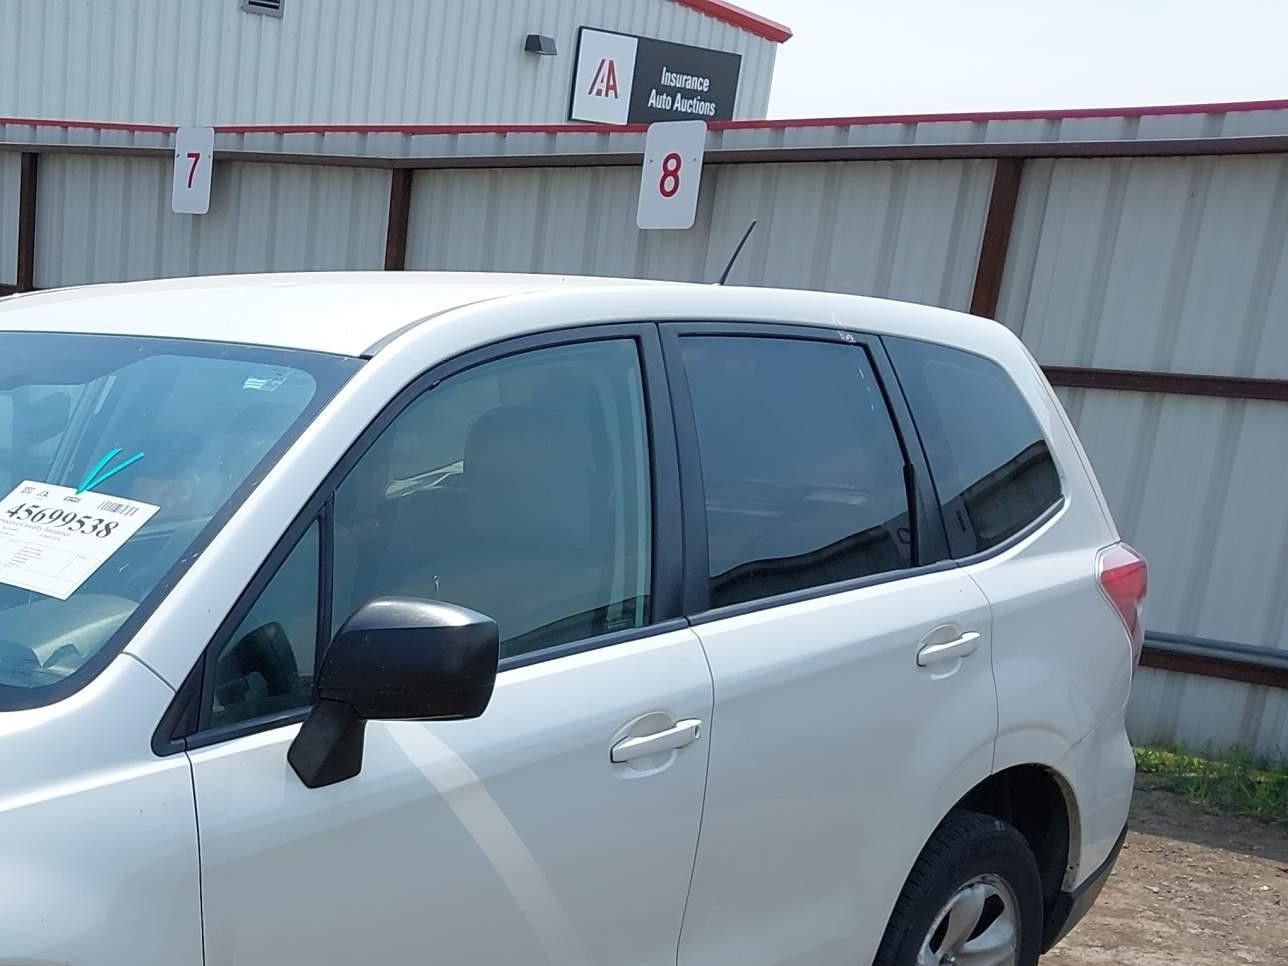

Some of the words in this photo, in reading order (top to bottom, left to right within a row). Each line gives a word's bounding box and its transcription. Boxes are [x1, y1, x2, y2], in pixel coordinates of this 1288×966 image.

[661, 66, 710, 92] Insurance
[648, 88, 672, 110] Auto
[673, 92, 716, 116] Auctions
[187, 152, 201, 189] 7
[659, 153, 682, 198] 8
[7, 502, 119, 539] 45699538
